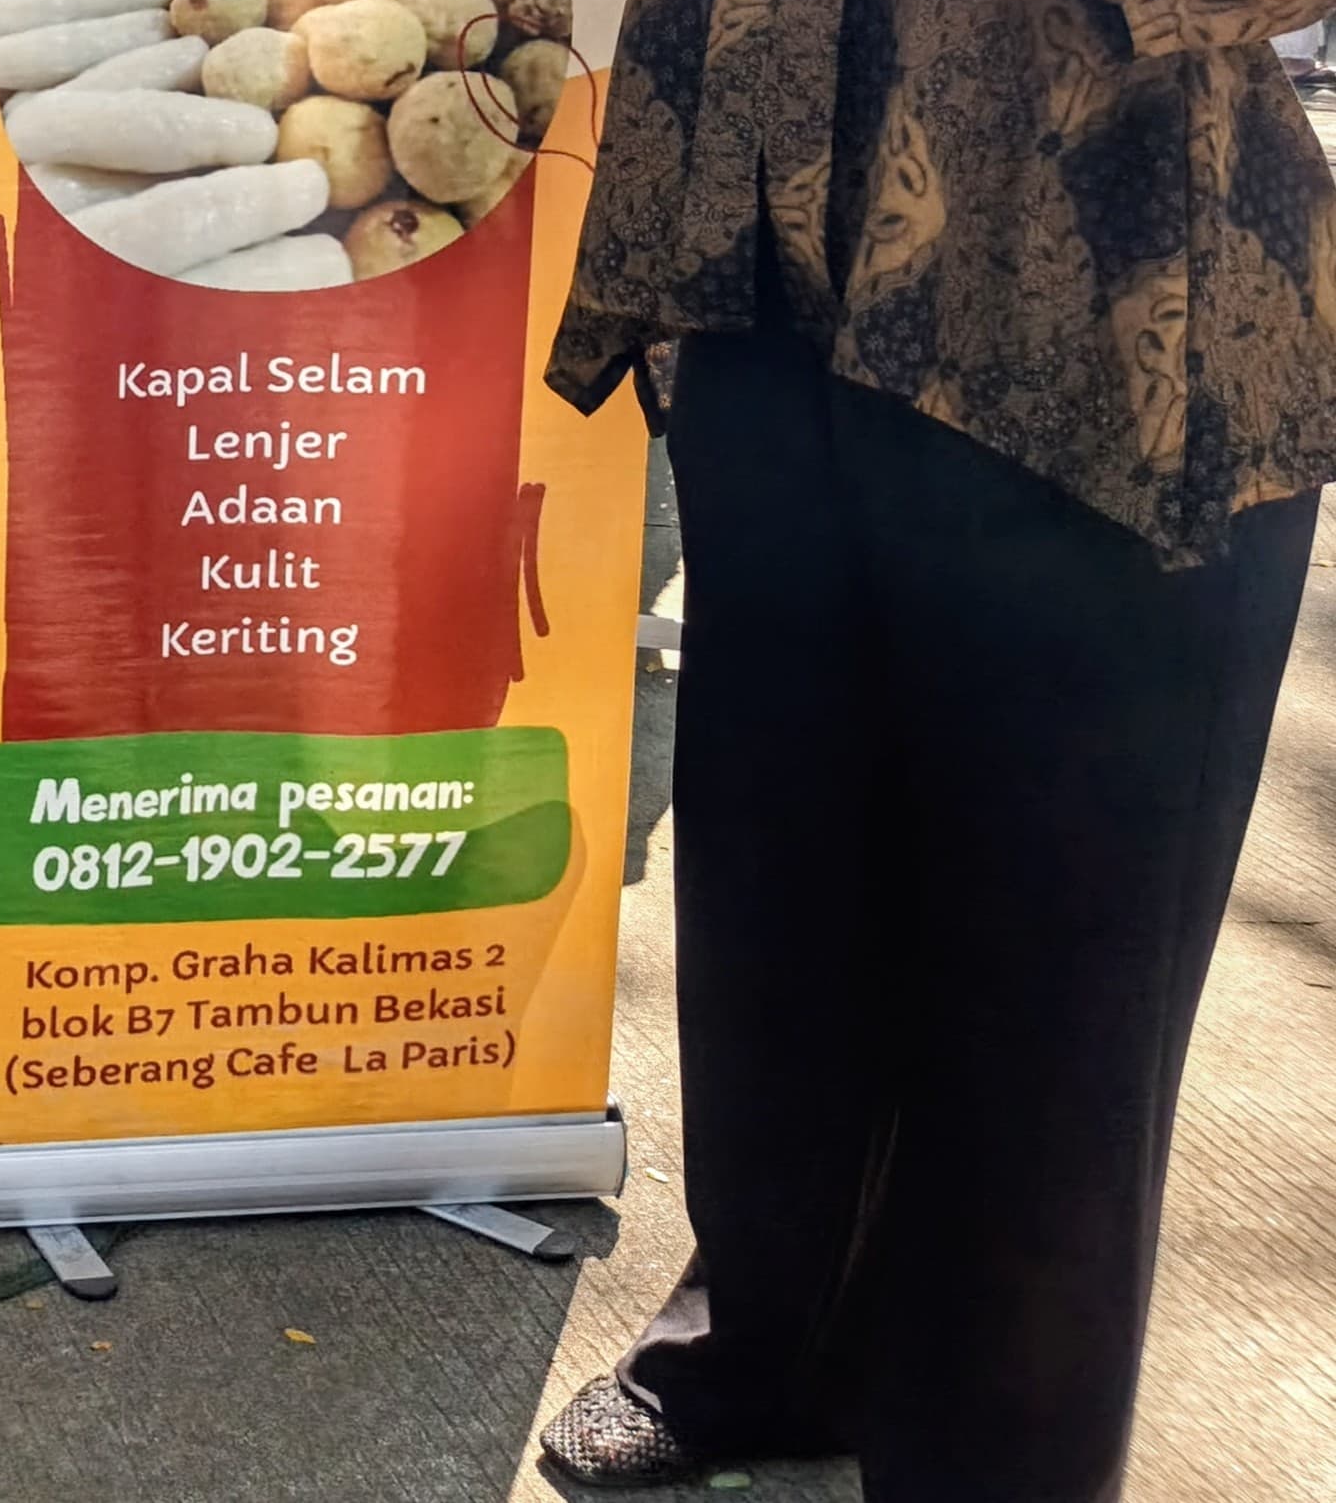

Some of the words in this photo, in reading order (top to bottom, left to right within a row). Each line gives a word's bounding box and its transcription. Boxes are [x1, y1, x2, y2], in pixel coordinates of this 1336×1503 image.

[118, 352, 252, 407] Kapal
[267, 352, 427, 395] Selam
[187, 420, 348, 470] Lenjer
[181, 484, 342, 527] Adaan
[200, 551, 321, 591] Kulit
[161, 615, 359, 666] Keriting
[29, 772, 259, 826] Menerima
[279, 777, 475, 828] pesanan:
[31, 830, 468, 892] 0812-1902-2577
[25, 958, 160, 994] Komp.
[171, 942, 295, 982] Graha
[308, 941, 473, 976] Kalimas
[485, 944, 507, 970] 2
[21, 1003, 115, 1041] blok
[127, 1004, 175, 1041] B7
[189, 993, 359, 1032] Tambun
[374, 985, 506, 1024] Bekasi
[4, 1052, 216, 1097] (Seberang
[226, 1043, 319, 1079] Cafe
[343, 1044, 388, 1074] La
[400, 1029, 517, 1072] Paris)
